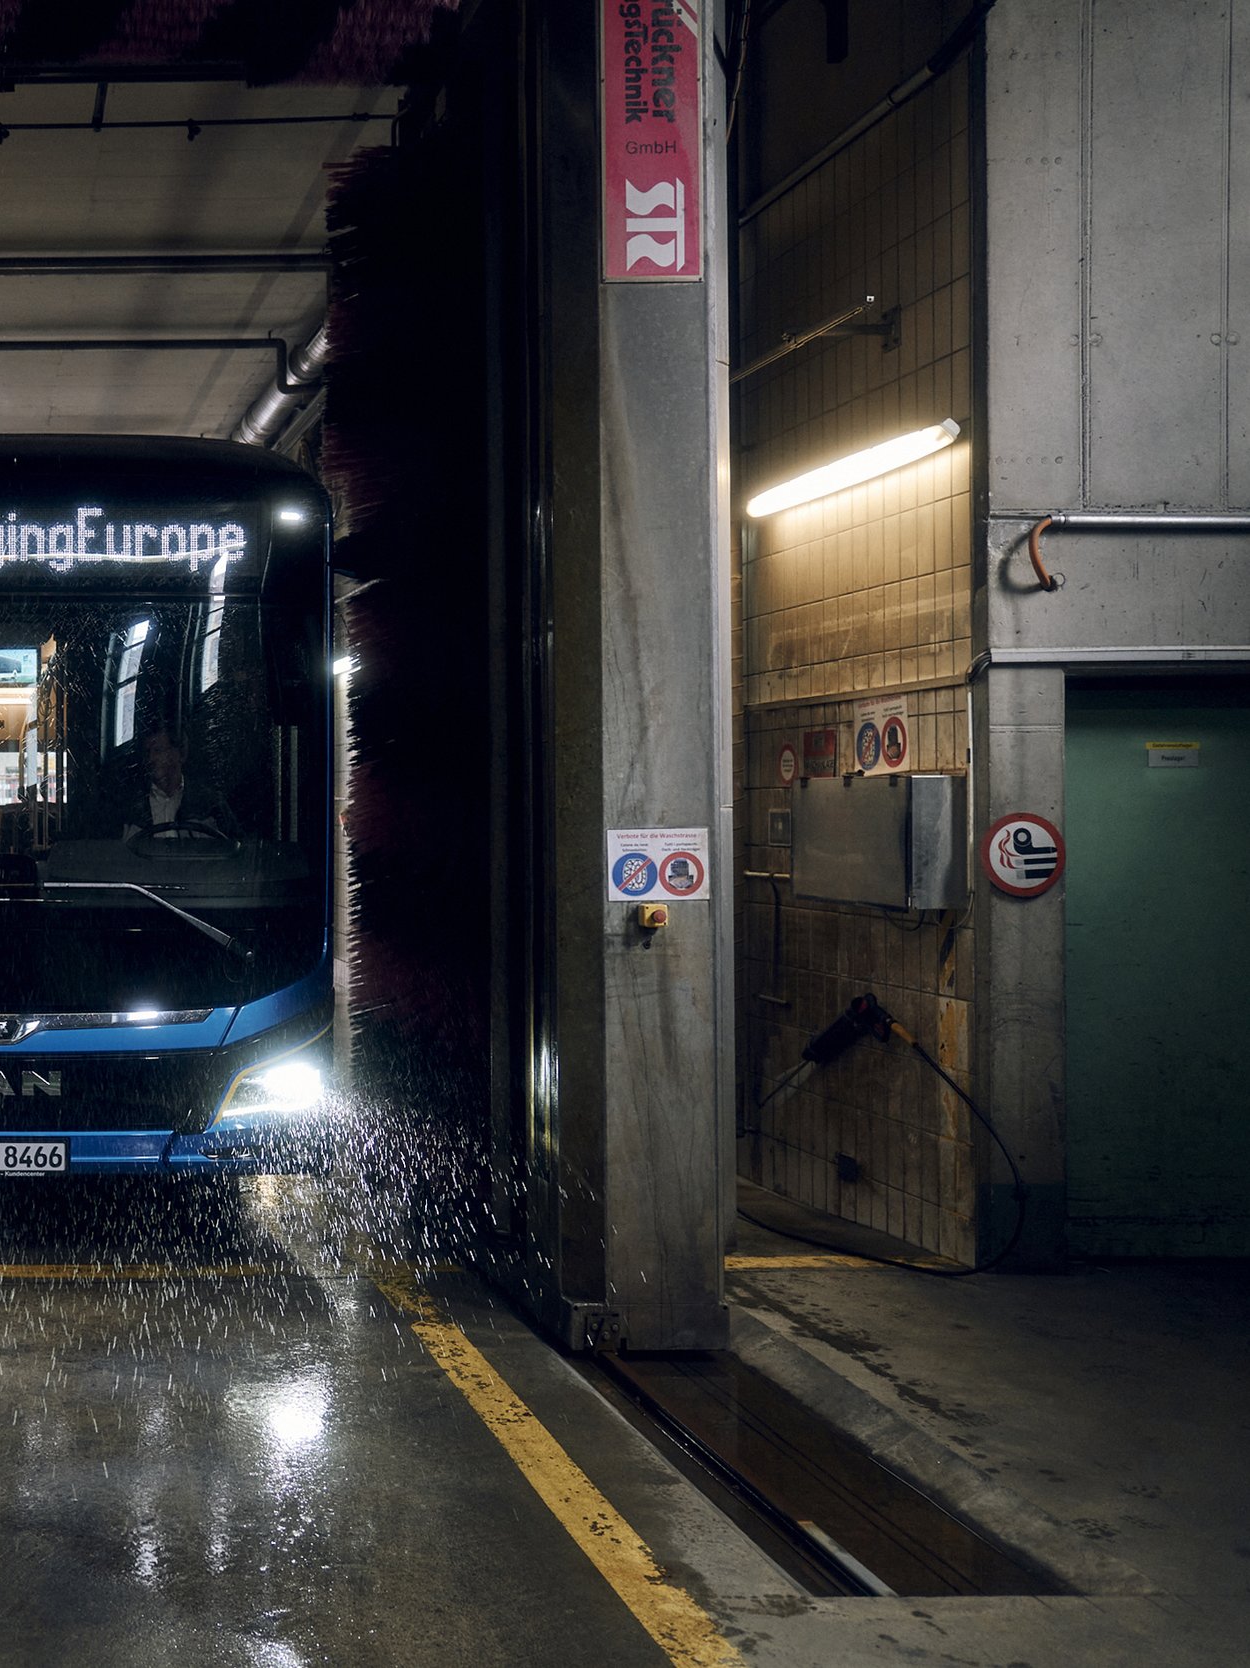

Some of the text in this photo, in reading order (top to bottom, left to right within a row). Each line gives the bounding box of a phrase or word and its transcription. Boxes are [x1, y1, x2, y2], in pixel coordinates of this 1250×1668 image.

[619, 0, 648, 124] gsTechnik
[626, 140, 677, 154] GmbH
[4, 1145, 63, 1168] 8466
